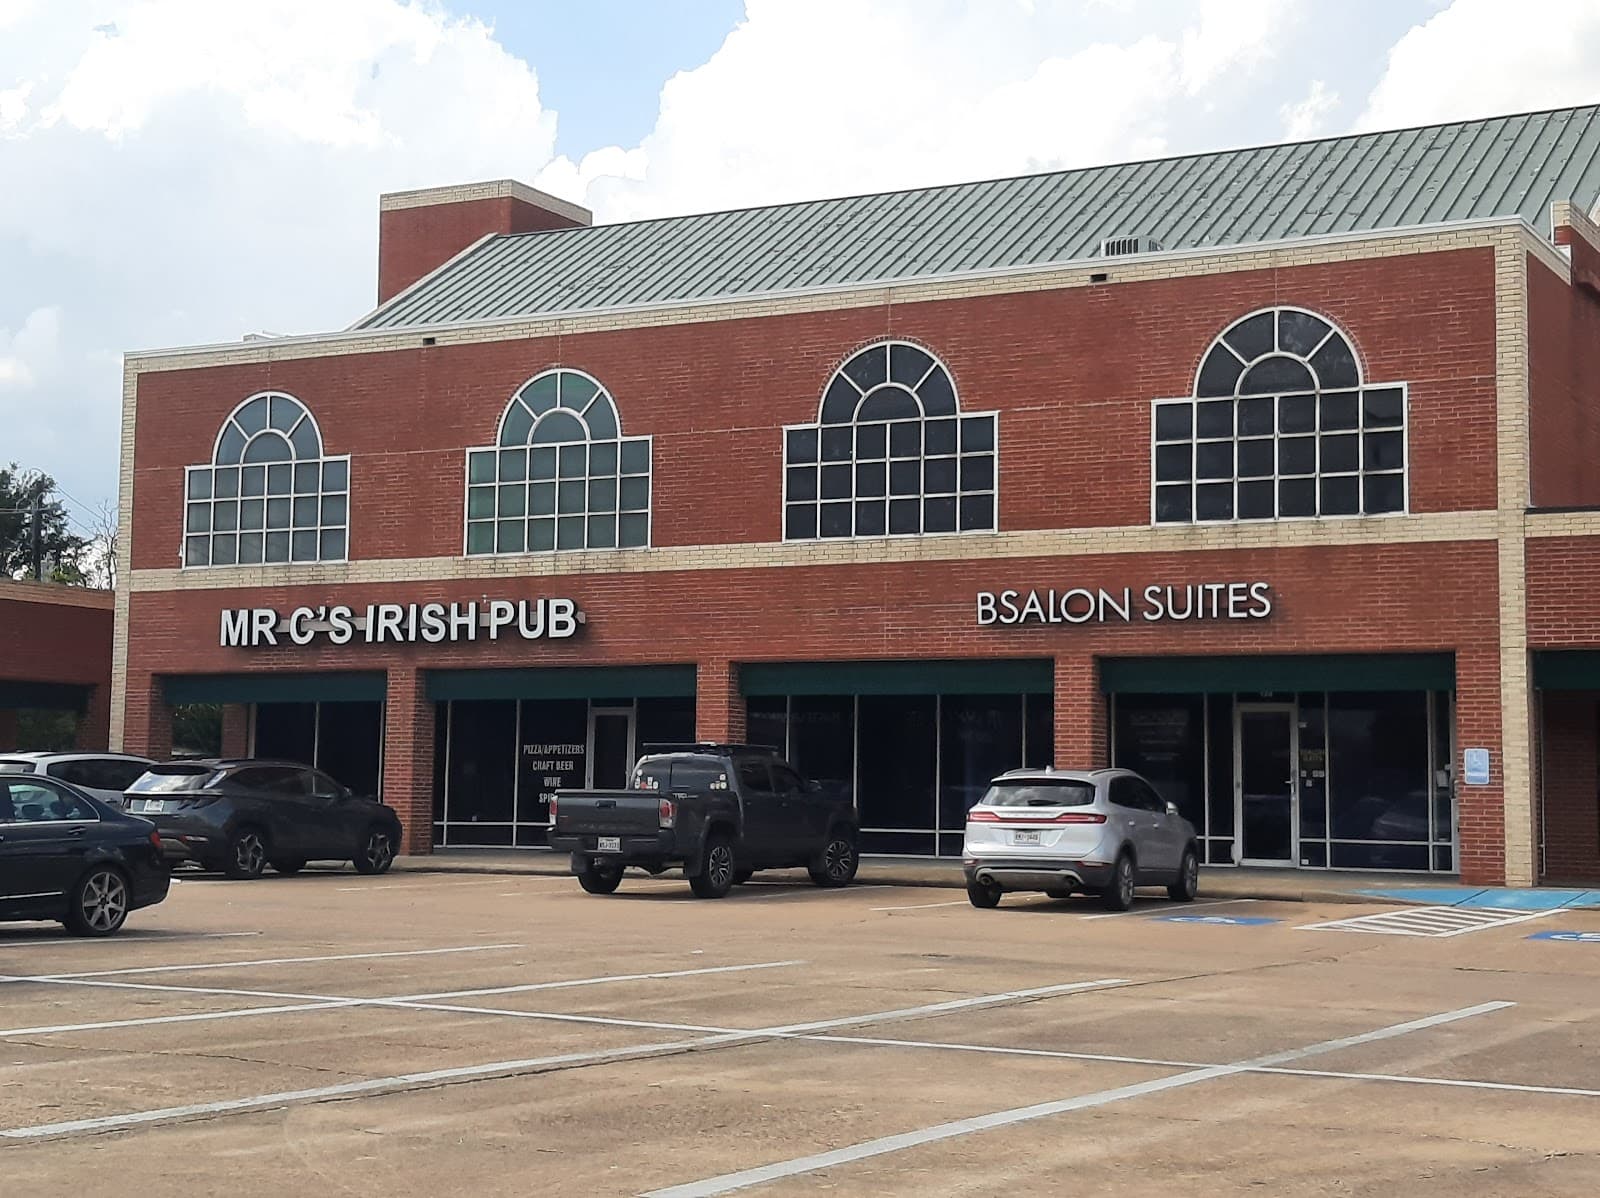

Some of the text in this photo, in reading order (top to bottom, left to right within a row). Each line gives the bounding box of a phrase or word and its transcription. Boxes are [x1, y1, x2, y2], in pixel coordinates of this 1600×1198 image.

[976, 582, 1272, 625] BSALON SUITES
[220, 598, 577, 647] MR C'S IRISH PUB
[532, 760, 574, 771] CRAFT BEER
[543, 776, 562, 787] WINE
